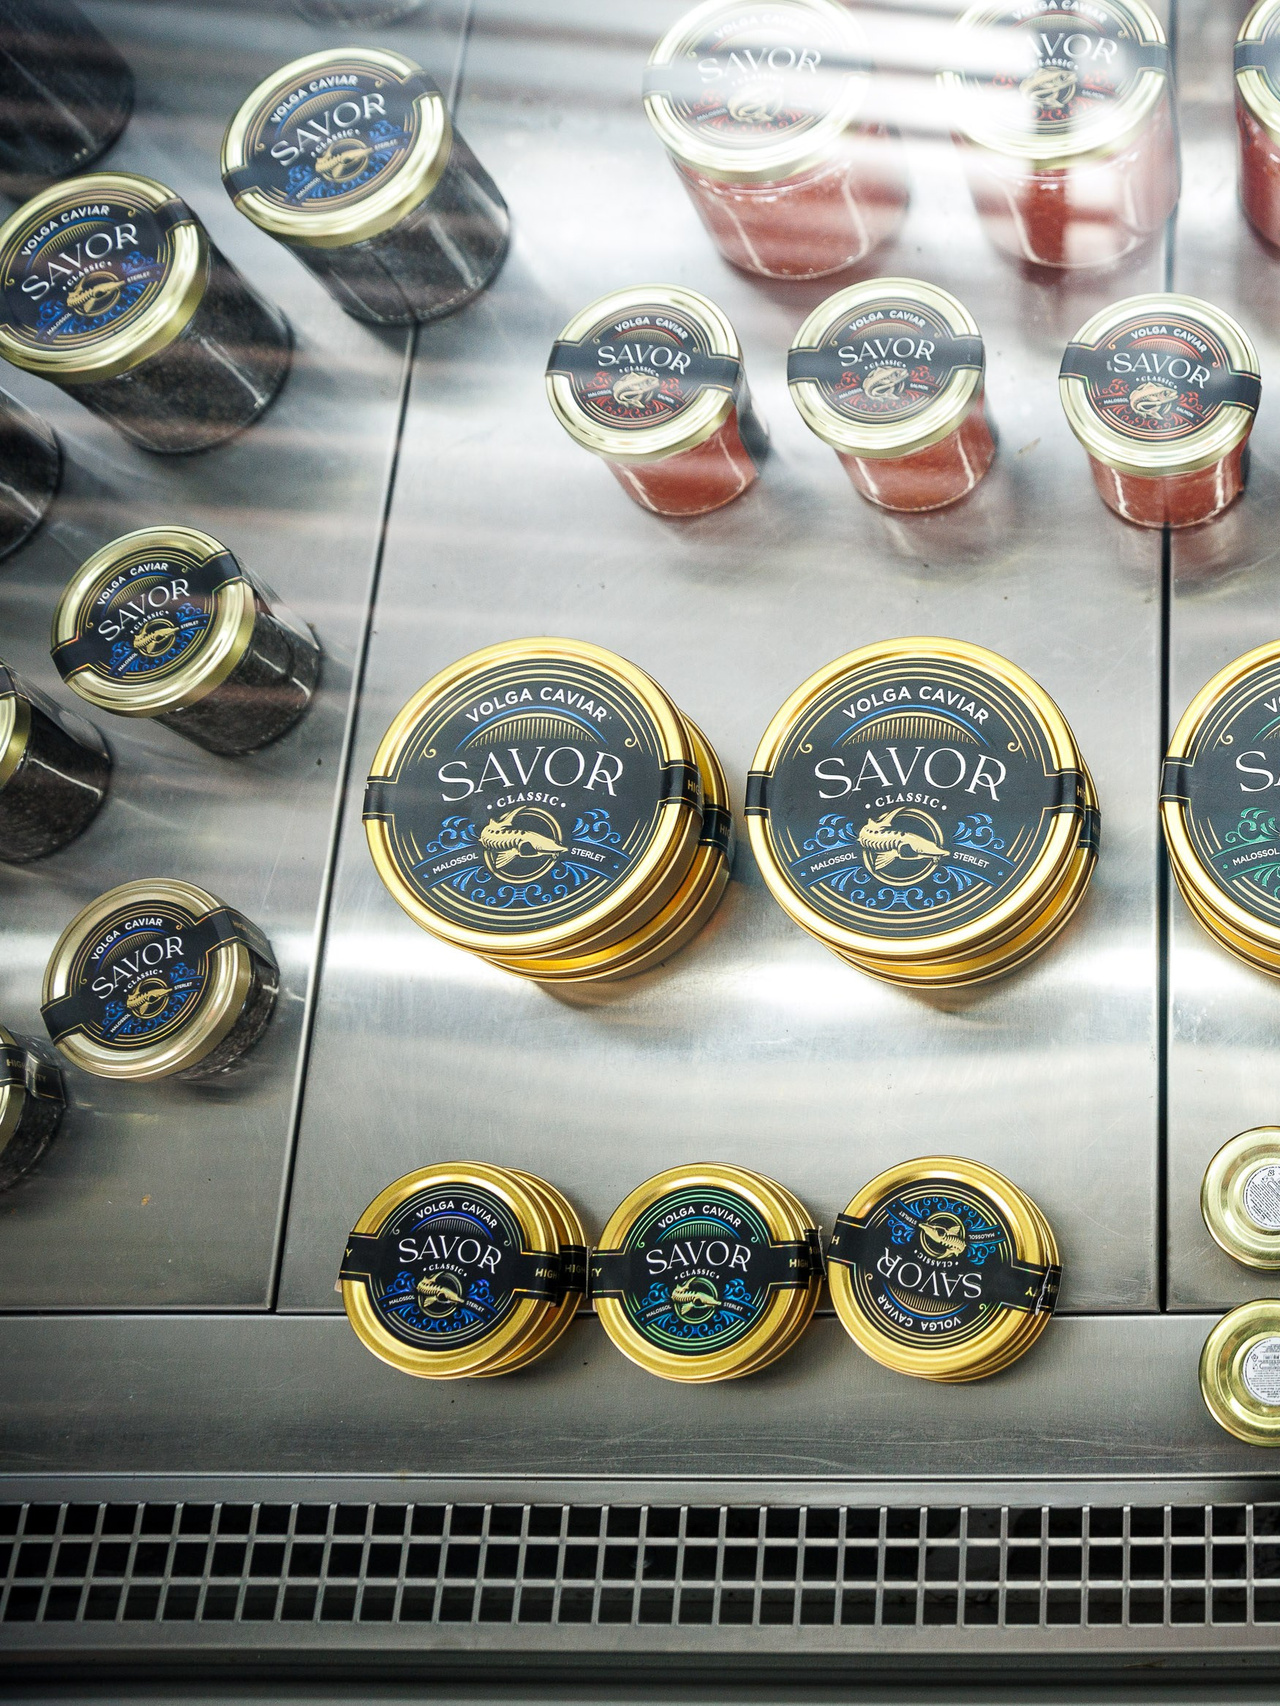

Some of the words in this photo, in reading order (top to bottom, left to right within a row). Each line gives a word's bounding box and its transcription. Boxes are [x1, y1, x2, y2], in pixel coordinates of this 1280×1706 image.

[1013, 1, 1058, 21] VOLGA
[1061, 1, 1108, 23] CAVIAR
[697, 47, 821, 83] SAVOR
[271, 89, 308, 123] VOLGA
[309, 75, 358, 93] CAVIAR
[271, 93, 387, 166] SAVOR
[316, 129, 354, 153] CLASSIC
[21, 220, 59, 257] VOLGA
[61, 205, 110, 223] CAVIAR
[22, 224, 139, 300] SAVOR
[67, 262, 106, 285] CLASSIC
[615, 317, 650, 332] VOLGA
[656, 317, 688, 339] CAVIAR
[849, 312, 884, 331] VOLGA
[890, 310, 926, 328] CAVIAR
[838, 338, 935, 367] SAVOR
[1131, 326, 1167, 339] VOLGA
[1174, 328, 1207, 353] CAVIAR
[597, 344, 691, 375] SAVOR
[624, 366, 656, 375] CLASSIC
[869, 360, 903, 369] CLASSIC
[1113, 353, 1210, 389] SAVOR
[1141, 376, 1174, 386] CLASSIC
[97, 576, 126, 605] VOLGA
[130, 563, 169, 576] CAVIAR
[98, 579, 191, 642] SAVOR
[134, 610, 165, 631] CLASSIC
[181, 621, 199, 629] STERLET
[466, 690, 533, 724] VOLGA
[540, 687, 609, 722] CAVIAR
[842, 687, 911, 720] VOLGA
[918, 686, 990, 724] CAVIAR
[437, 745, 623, 802] SAVOR
[815, 746, 1006, 801] SAVOR
[496, 791, 559, 807] CLASSIC
[875, 792, 940, 808] CLASSIC
[571, 847, 605, 862] STERLET
[953, 852, 990, 868] STERLET
[91, 930, 120, 960] VOLGA
[124, 918, 163, 930] CAVIAR
[92, 936, 184, 999] SAVOR
[128, 969, 158, 989] CLASSIC
[174, 982, 193, 990] STERLET
[416, 1201, 454, 1219] VOLGA
[461, 1202, 497, 1228] CAVIAR
[658, 1206, 696, 1228] VOLGA
[703, 1205, 741, 1227] CAVIAR
[399, 1235, 501, 1274] SAVOR
[646, 1241, 751, 1275] SAVOR
[918, 1252, 952, 1267] CLASSIC
[429, 1263, 464, 1274] CLASSIC
[680, 1269, 716, 1279] CLASSIC
[877, 1247, 983, 1299] SAVOR
[877, 1296, 913, 1327] CAVIAR
[921, 1317, 961, 1331] VOLGA
